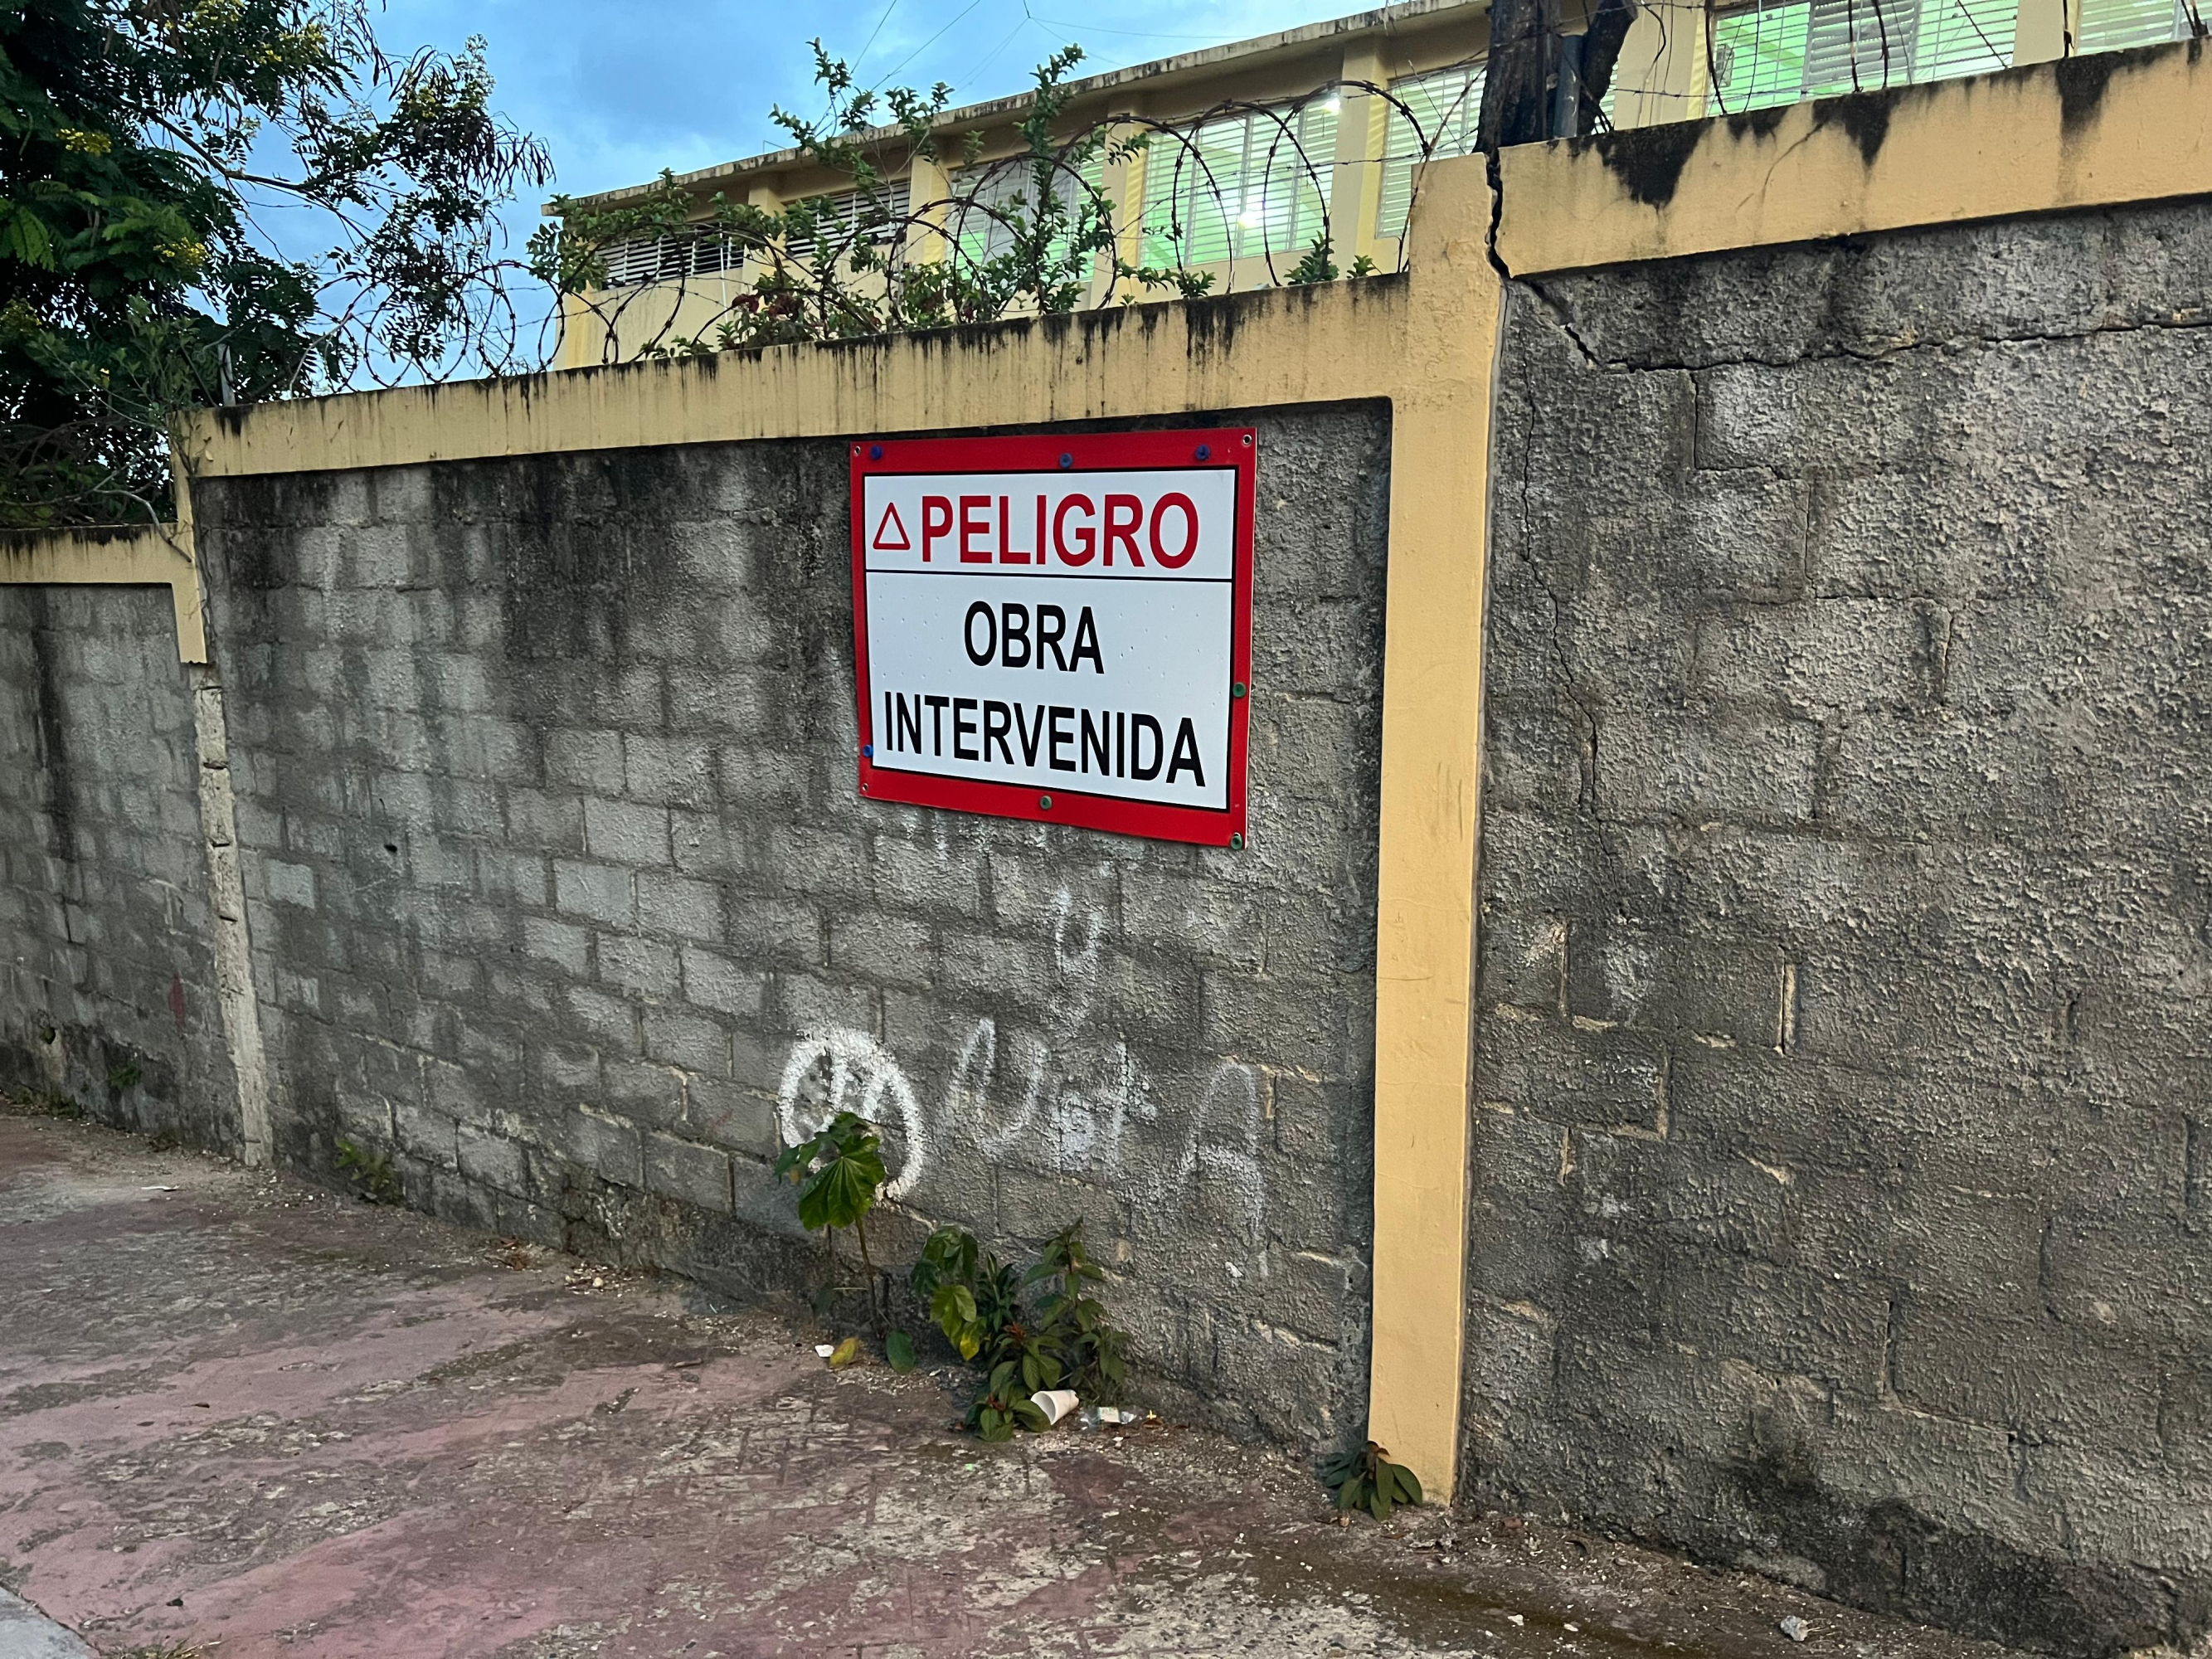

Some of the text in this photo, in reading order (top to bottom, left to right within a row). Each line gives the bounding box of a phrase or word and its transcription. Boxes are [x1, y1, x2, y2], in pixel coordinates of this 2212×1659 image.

[921, 492, 1199, 569] PELIGRO
[964, 601, 1105, 674] OBRA
[884, 691, 1206, 787] INTERVENIDA
